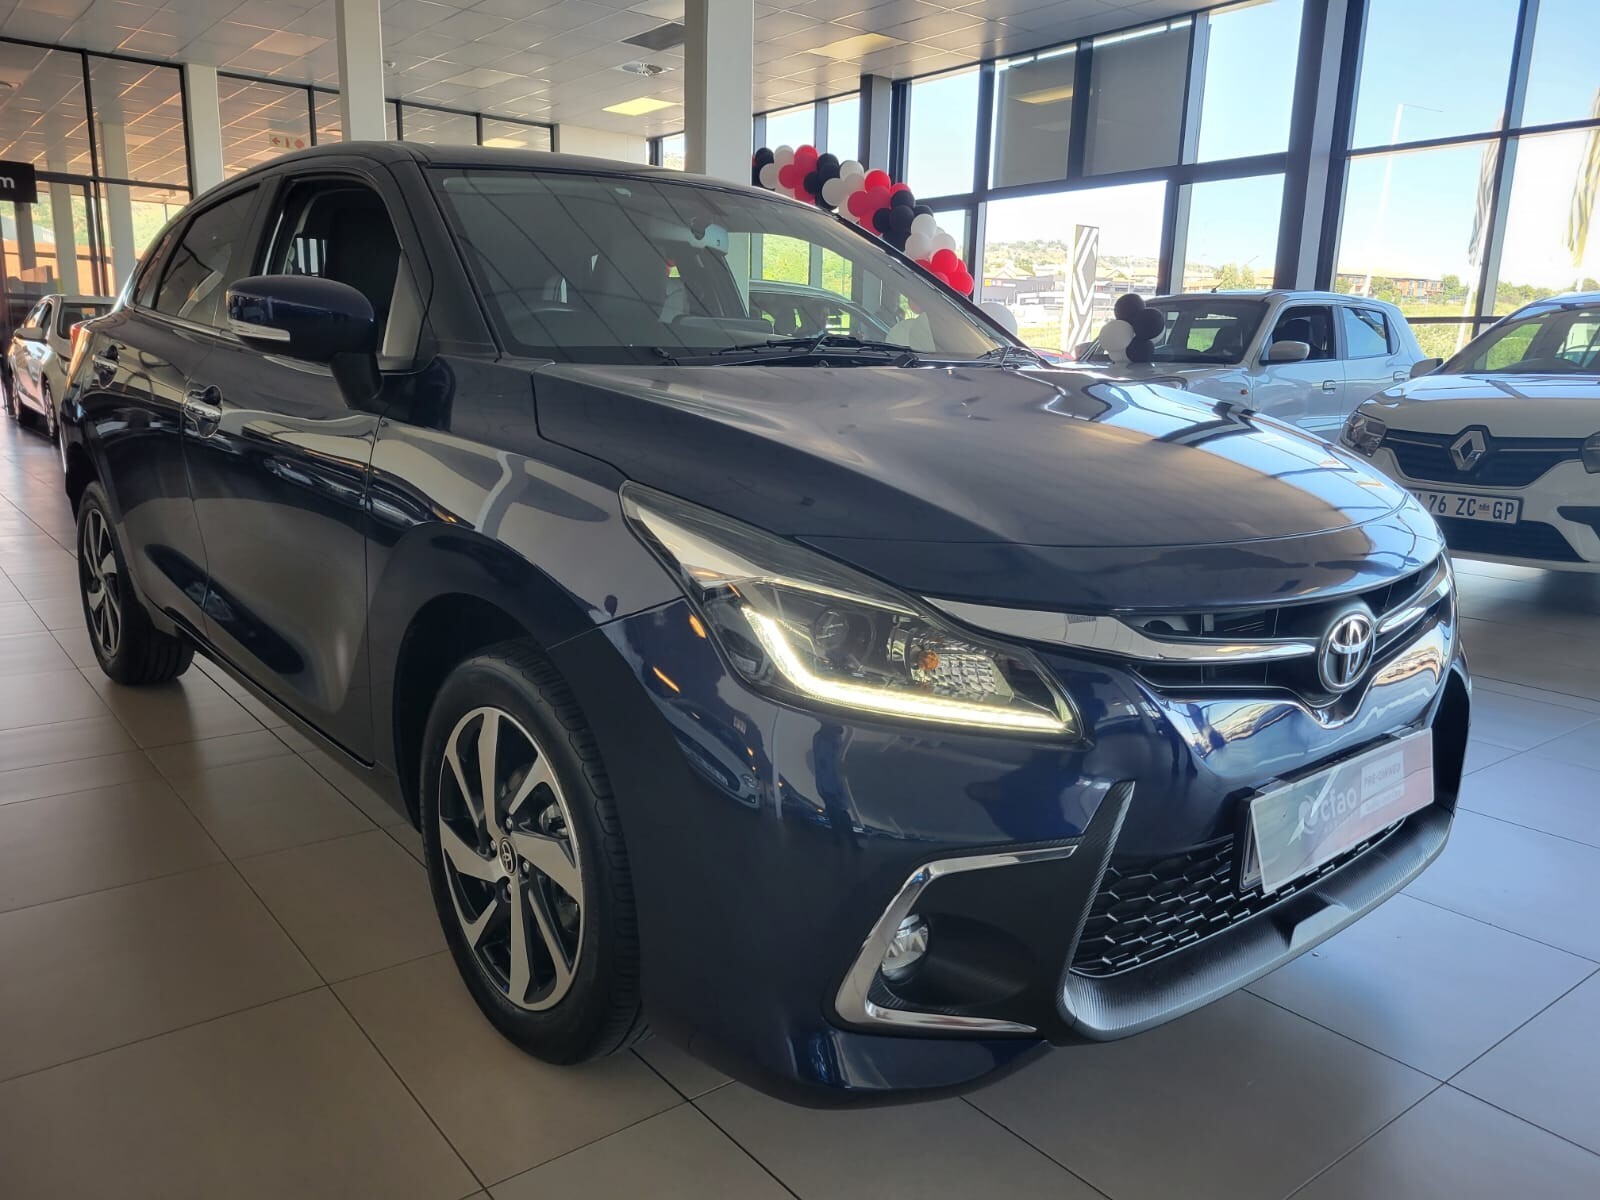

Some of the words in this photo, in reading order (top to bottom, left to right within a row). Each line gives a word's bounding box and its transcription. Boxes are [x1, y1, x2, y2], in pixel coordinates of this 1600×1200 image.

[1429, 494, 1447, 514] 76
[1455, 497, 1477, 517] ZC
[1492, 501, 1515, 521] GP
[1320, 787, 1357, 822] cfao
